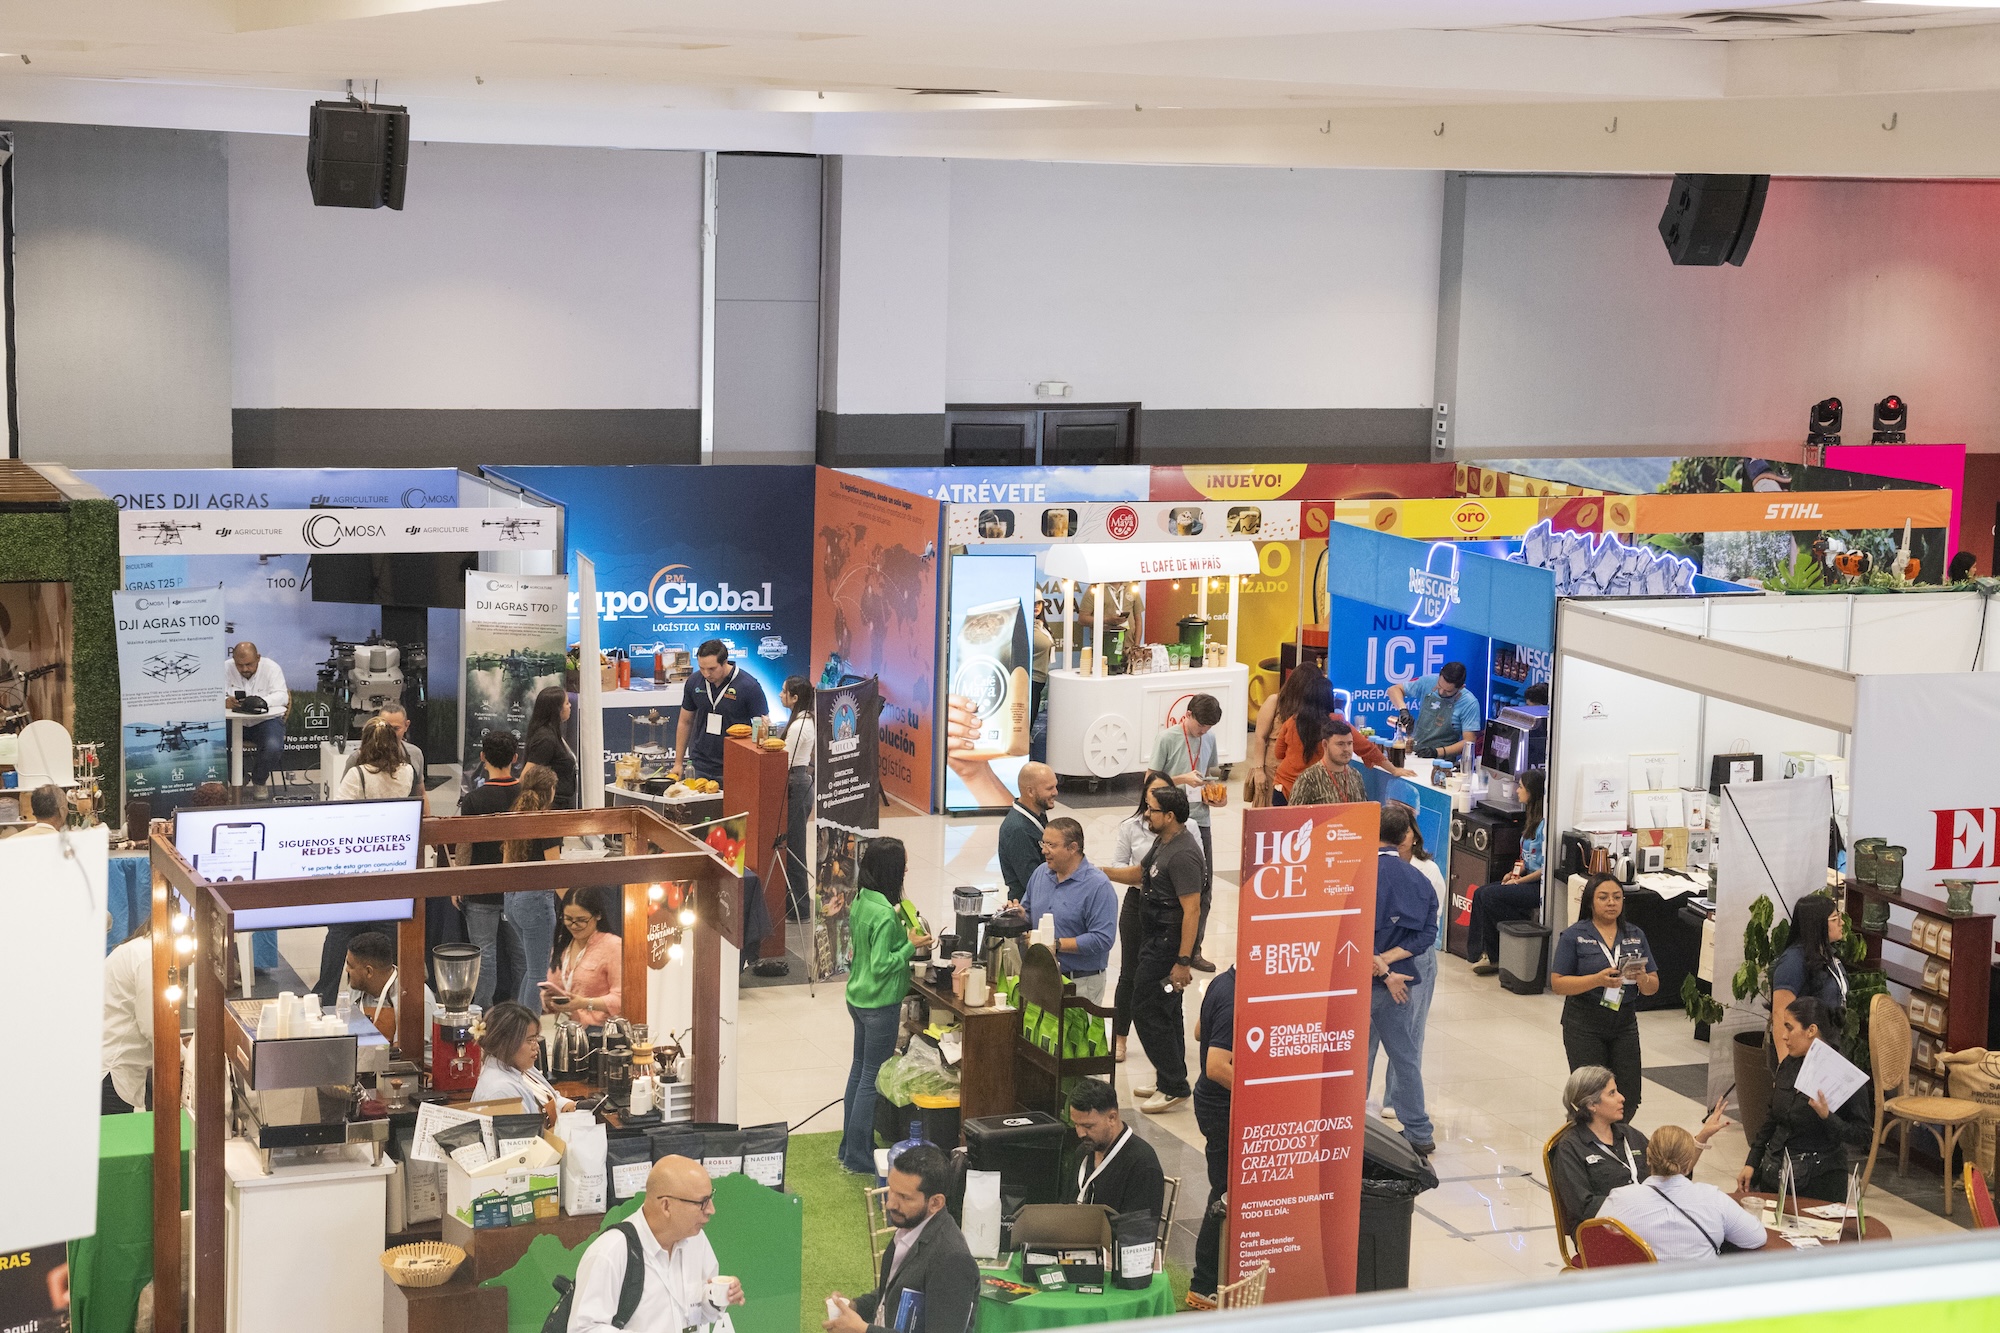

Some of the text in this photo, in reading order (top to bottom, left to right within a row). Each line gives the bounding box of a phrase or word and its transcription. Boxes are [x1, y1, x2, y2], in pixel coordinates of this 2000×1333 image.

[1207, 474, 1282, 489] ¡NUEVO!
[174, 494, 199, 509] DJI
[206, 493, 269, 509] AGRAS
[1457, 512, 1485, 523] oro
[1764, 503, 1823, 520] STIHL
[423, 526, 469, 534] AGRICULTURE
[1111, 517, 1135, 531] Maya
[1140, 554, 1221, 574] EL CAFÉ DE MI PAÍS
[157, 578, 175, 589] T25
[266, 578, 296, 588] T100
[665, 574, 687, 583] P.M.
[655, 582, 774, 614] Global
[477, 600, 492, 610] DJI
[495, 602, 529, 612] AGRAS
[531, 603, 550, 612] T70
[1425, 597, 1441, 618] ICE
[119, 614, 220, 631] DJI AGRAS T100
[652, 622, 771, 632] LOGÍSTICA SIN FRONTERAS
[1366, 635, 1448, 685] ICE
[1358, 702, 1375, 712] UN
[908, 708, 919, 730] tu
[309, 734, 328, 742] afect
[278, 833, 411, 849] SIGUENOS EN NUESTRAS
[1253, 830, 1312, 865] HO
[302, 842, 406, 857] REDES SOCIALES
[316, 865, 332, 874] parte
[357, 864, 371, 872] gran
[373, 860, 407, 868] comunidad
[1253, 864, 1307, 900] CE
[1323, 884, 1354, 896] cigüeña
[1265, 941, 1321, 960] BREW
[1265, 957, 1315, 975] BLVD.
[1269, 1022, 1322, 1037] ZONA DE
[1270, 1029, 1355, 1047] EXPERIENCIAS
[1269, 1041, 1351, 1058] SENSORIALES
[1241, 1115, 1354, 1140] DEGUSTACIONES,
[1241, 1134, 1319, 1155] MÉTODOS Y
[1241, 1146, 1350, 1171] CREATIVIDAD EN
[622, 1164, 651, 1173] CIRUELOS
[1240, 1167, 1294, 1185] LA TAZA
[1241, 1192, 1334, 1210] ACTIVACIONES DURANTE
[1241, 1206, 1289, 1220] TODO EL DÍA:
[1240, 1231, 1260, 1239] Artea
[1240, 1236, 1295, 1249] Craft Bartender
[1122, 1244, 1154, 1255] ESPERANZA
[1239, 1244, 1301, 1259] Claupuccino Gifts
